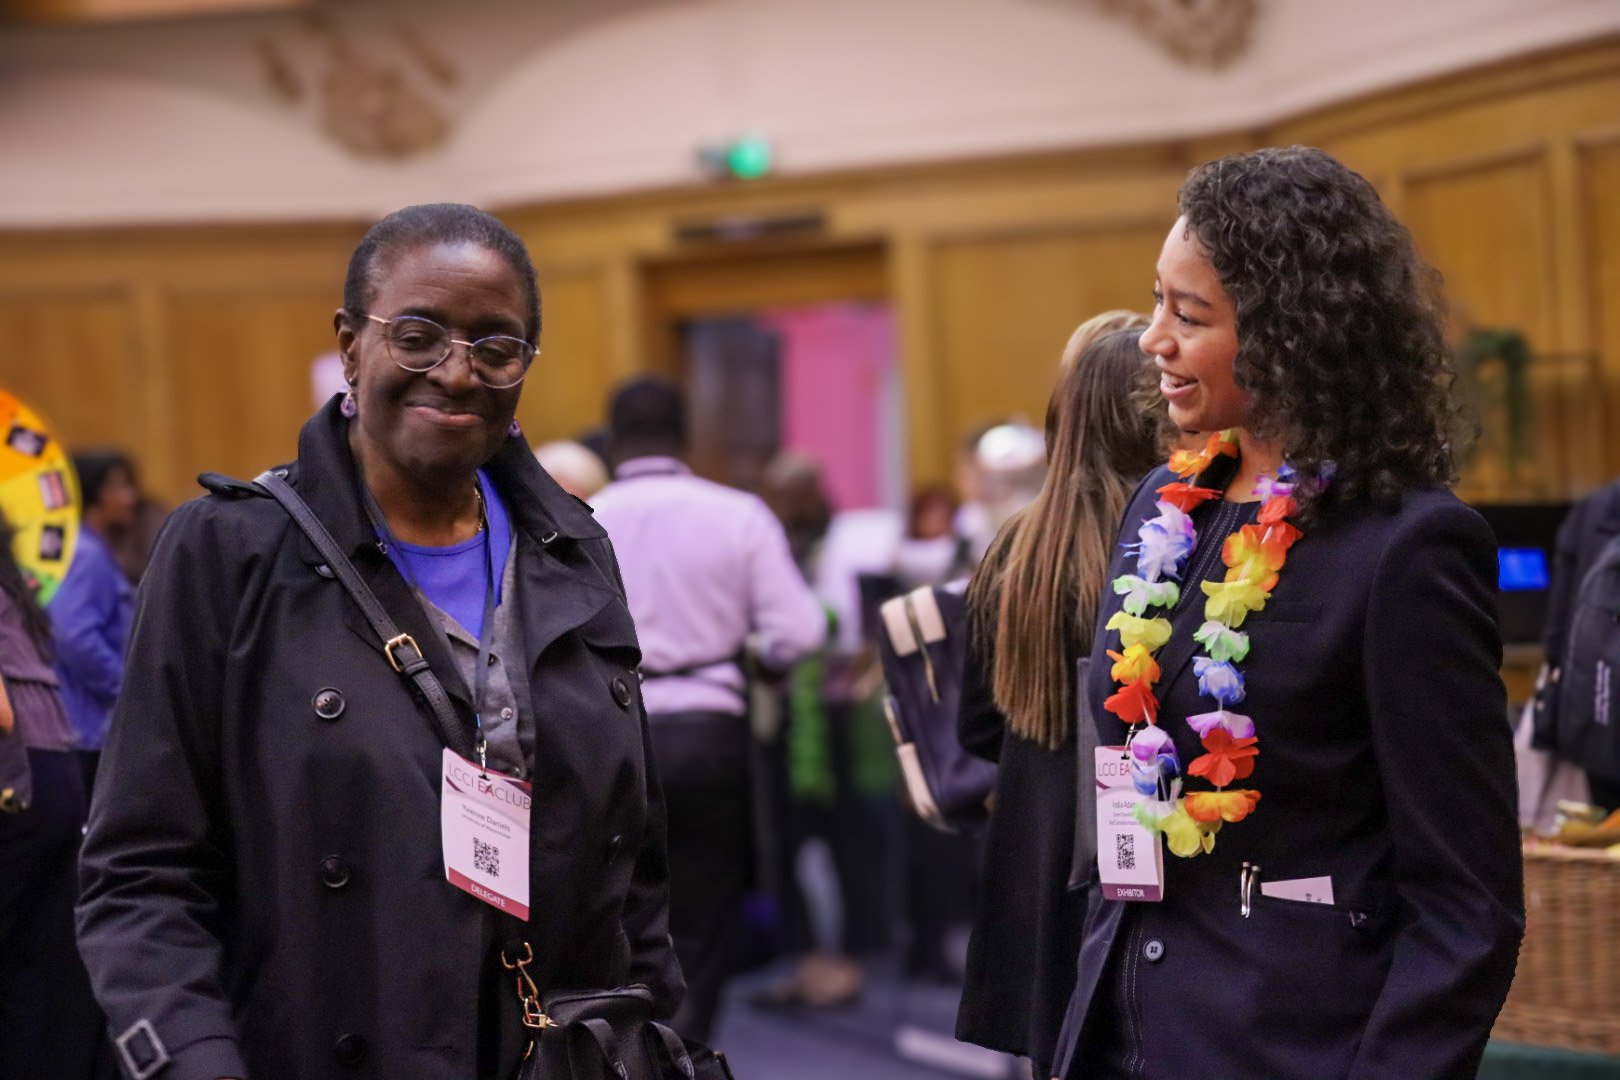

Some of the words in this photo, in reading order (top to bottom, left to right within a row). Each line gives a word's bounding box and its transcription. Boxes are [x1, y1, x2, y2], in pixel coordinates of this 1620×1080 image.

[1098, 763, 1117, 776] LCCI
[1120, 763, 1133, 776] EA
[449, 763, 474, 787] LCCI
[478, 780, 531, 810] EACLUB
[487, 816, 511, 832] Daniels
[471, 884, 506, 907] DELEGATE
[1117, 888, 1145, 898] EXHIBITOR
